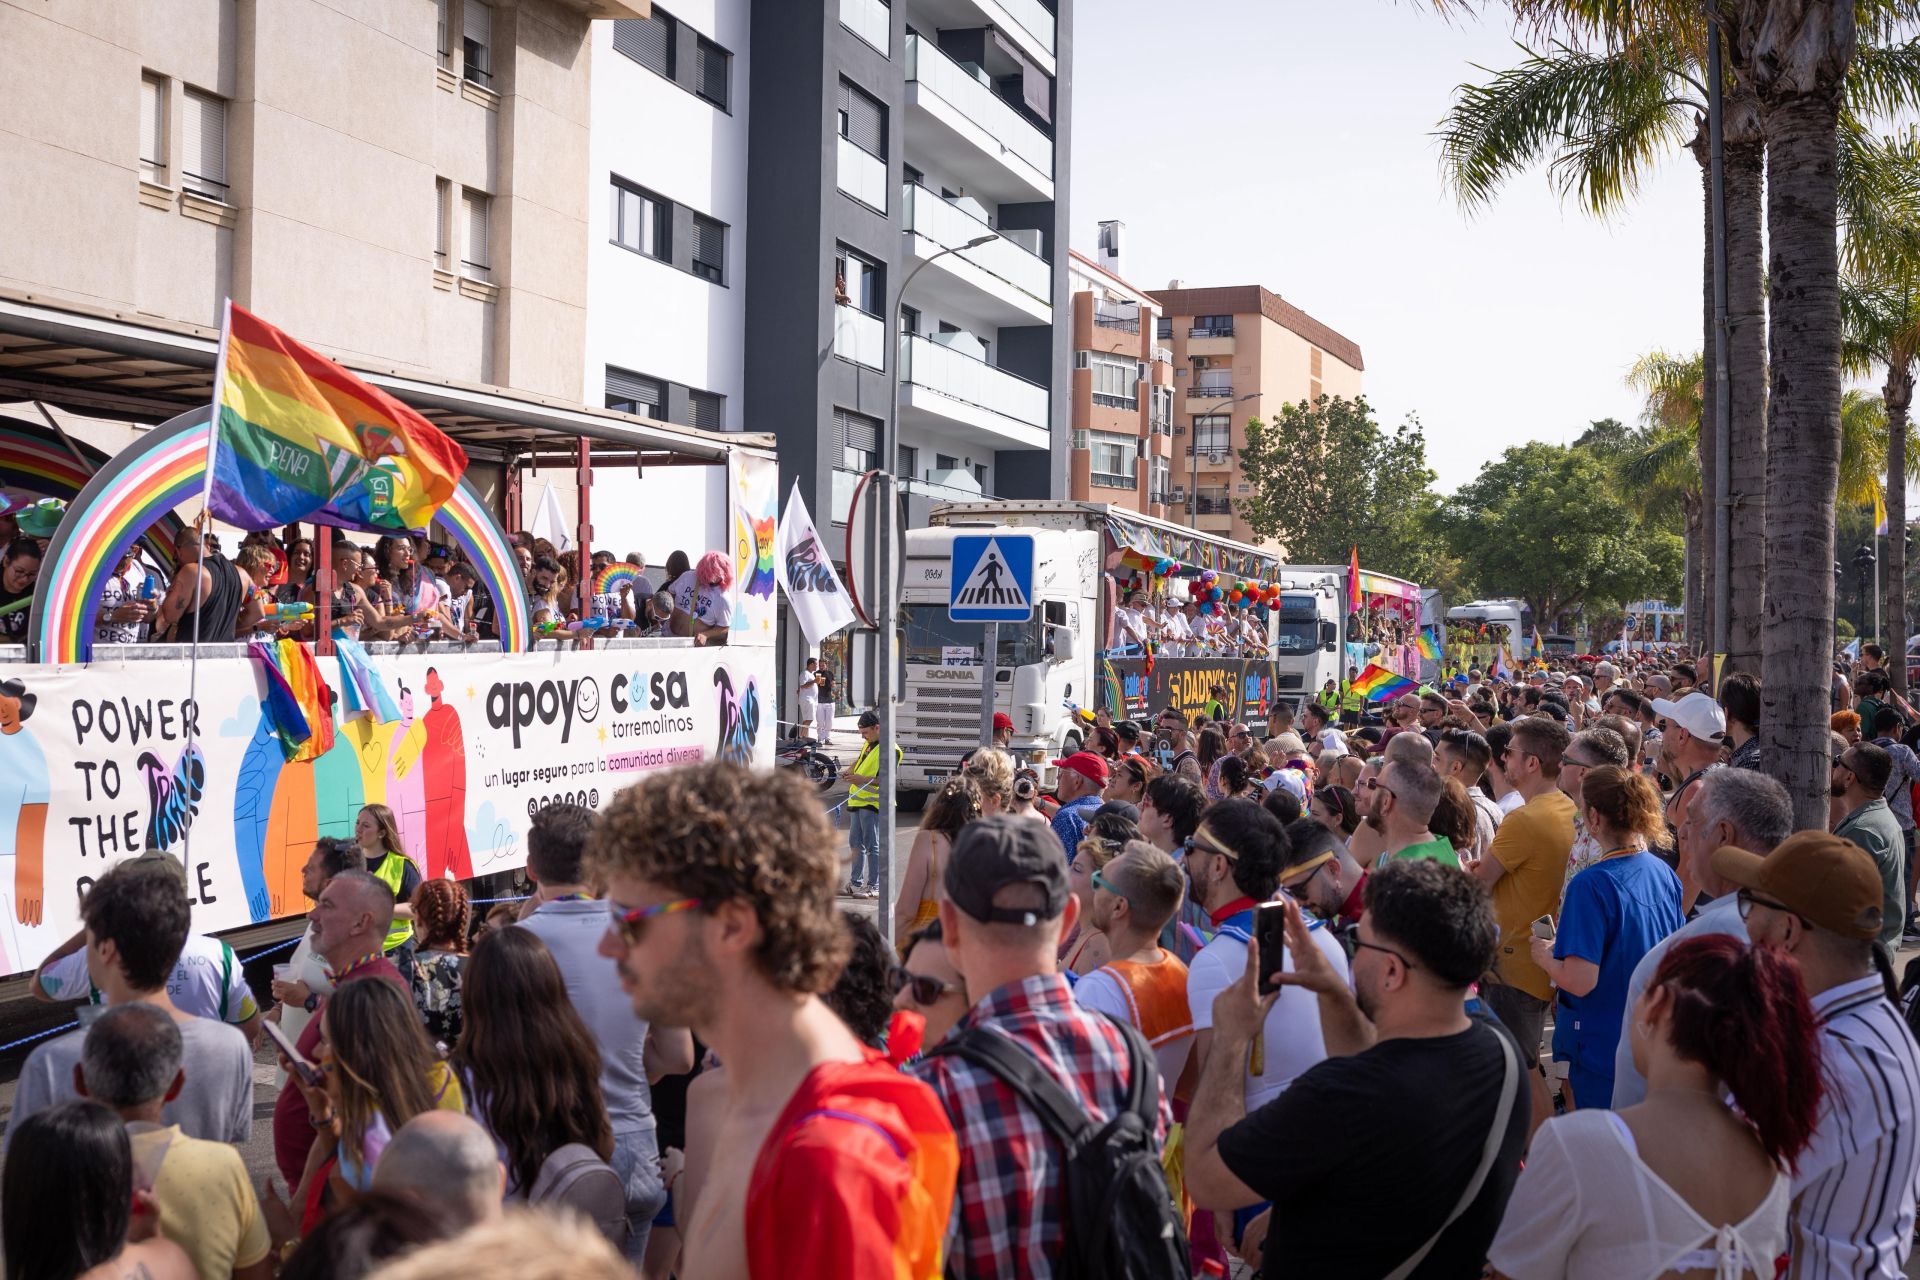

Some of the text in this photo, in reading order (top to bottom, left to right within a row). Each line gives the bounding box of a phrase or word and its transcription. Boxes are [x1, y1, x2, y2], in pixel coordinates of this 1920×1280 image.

[611, 670, 690, 714] casa
[925, 669, 975, 680] SCANIA
[1125, 672, 1149, 710] colega
[1245, 671, 1271, 716] colega
[72, 696, 201, 746] POWER
[486, 676, 600, 749] apoyo
[612, 714, 693, 738] torremolinos
[74, 758, 121, 801] TO
[484, 747, 700, 788] un lugar seguro para la comunidad diversa
[68, 810, 140, 858] THE
[188, 956, 205, 966] NO
